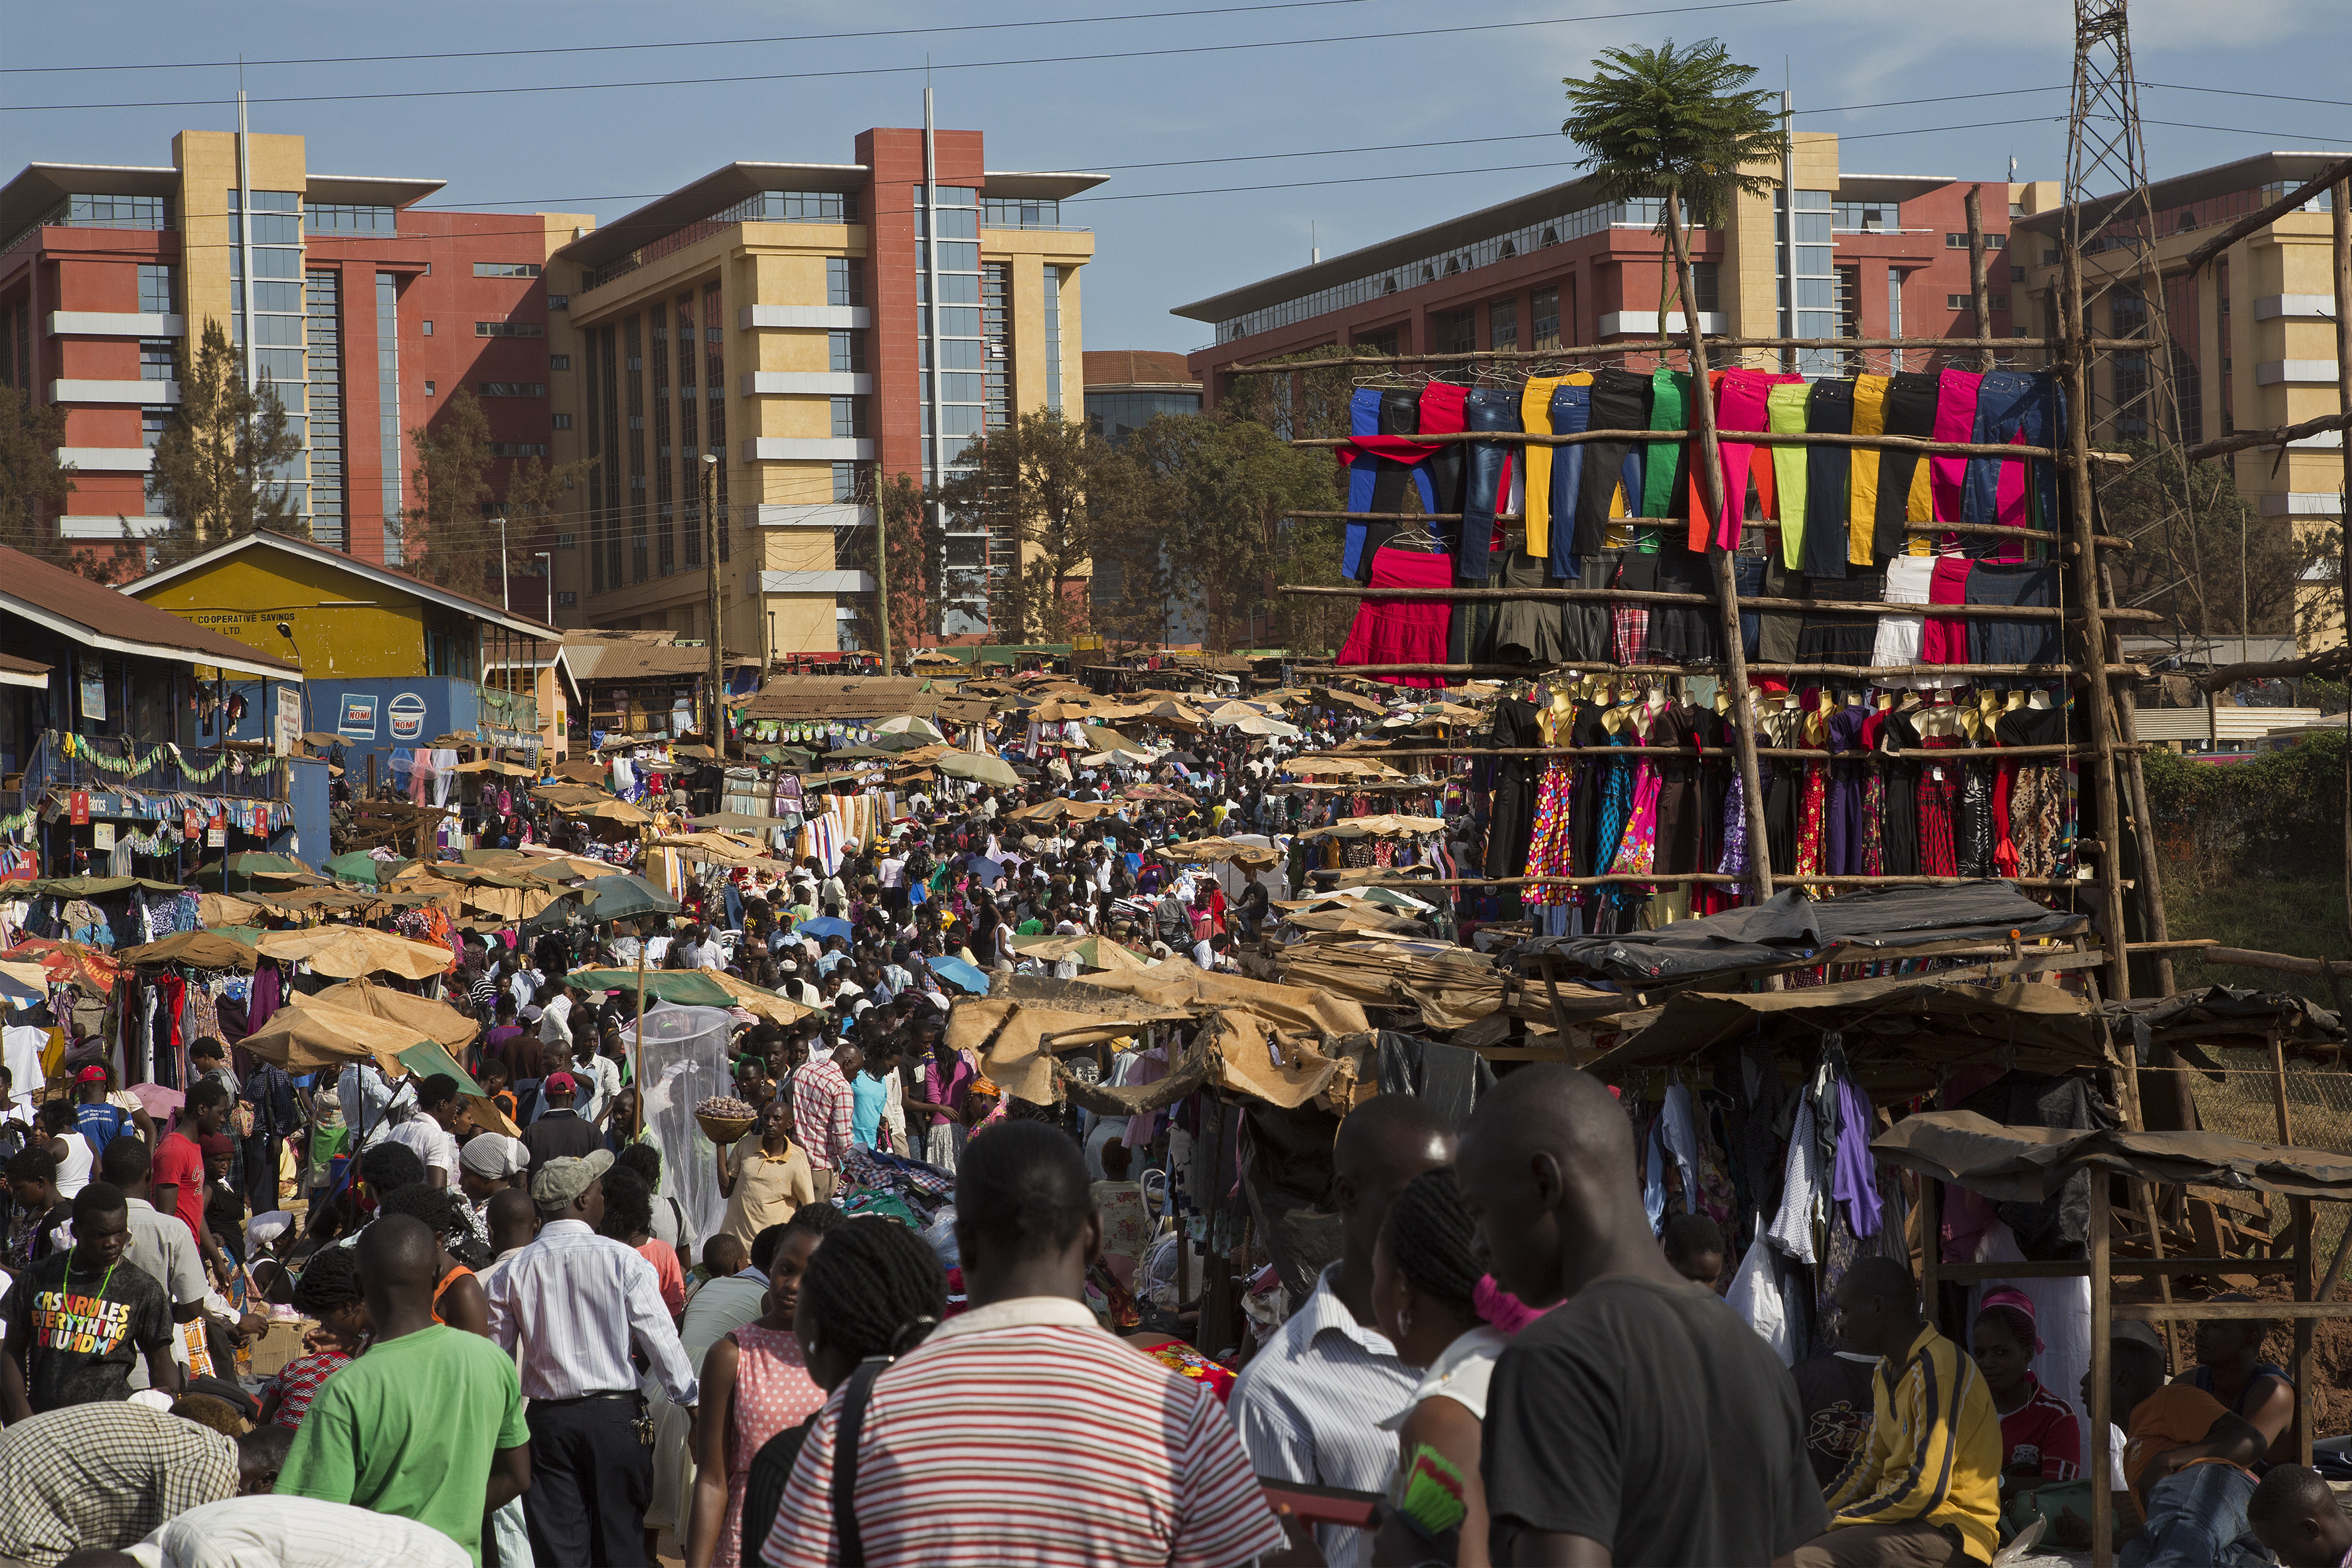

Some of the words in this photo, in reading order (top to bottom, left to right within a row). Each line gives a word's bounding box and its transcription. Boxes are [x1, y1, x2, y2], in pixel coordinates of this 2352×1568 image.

[261, 613, 295, 622] SAVINGS
[349, 710, 370, 720] NOMI
[394, 720, 416, 730] NOMI
[88, 796, 106, 812] fabrics
[190, 817, 198, 828] airtel
[31, 1310, 128, 1341] EVERYTHING
